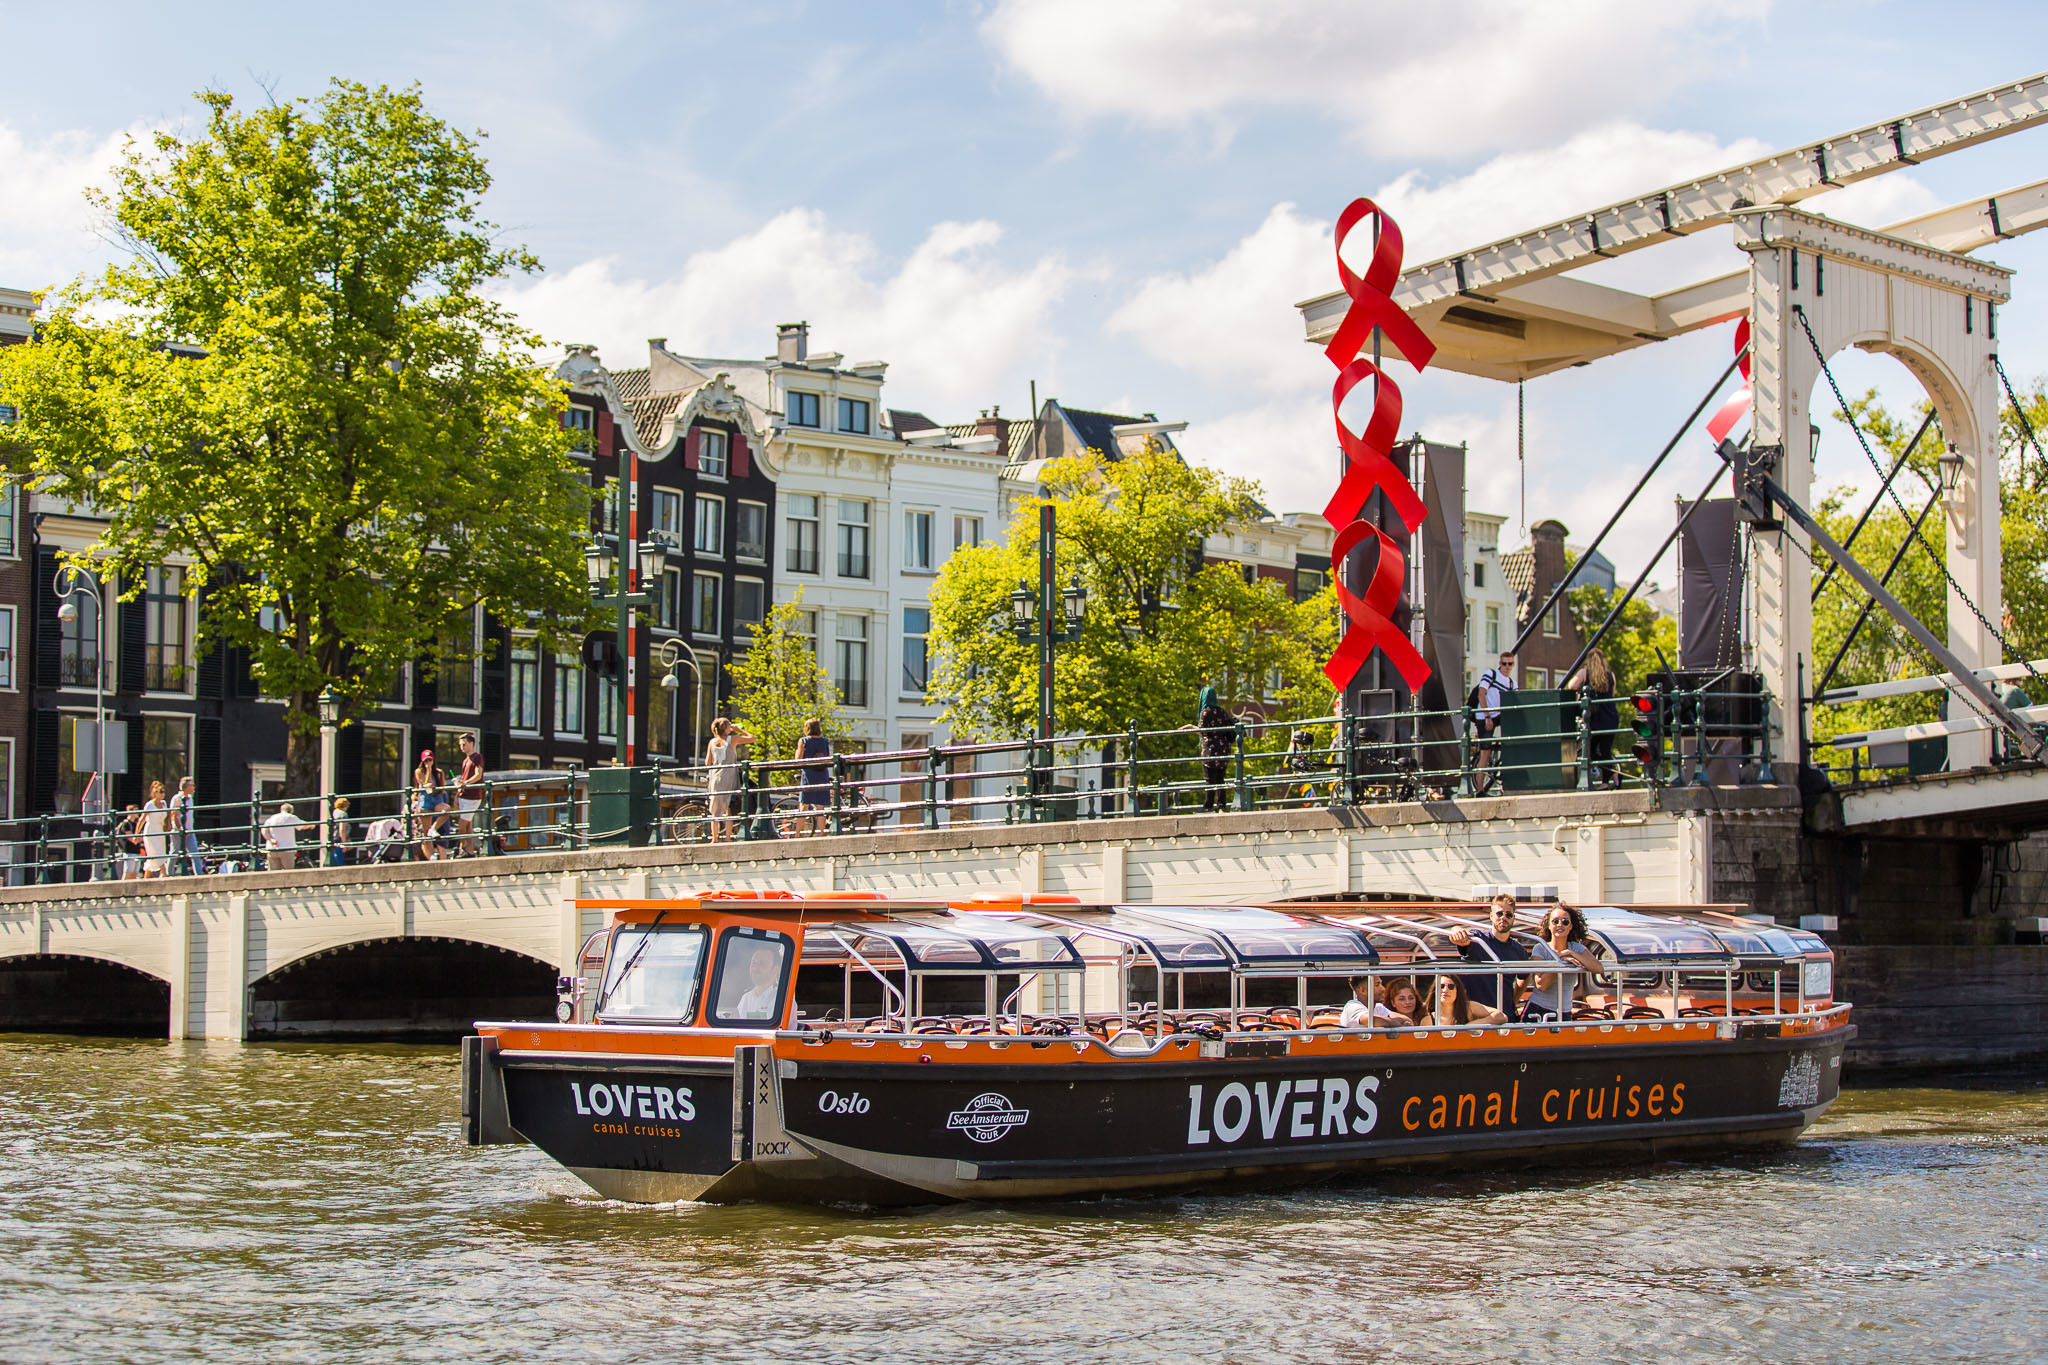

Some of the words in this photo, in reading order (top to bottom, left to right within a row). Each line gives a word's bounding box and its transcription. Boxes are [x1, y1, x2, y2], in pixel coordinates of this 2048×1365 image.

[570, 1082, 696, 1121] LOVERS
[818, 1090, 870, 1114] Oslo
[973, 1095, 1005, 1109] Official
[1187, 1075, 1380, 1145] LOVERS
[1402, 1079, 1520, 1131] canal
[1541, 1074, 1686, 1123] cruises
[593, 1121, 629, 1135] canal
[633, 1124, 681, 1138] cruises
[975, 1130, 999, 1140] TOUR
[756, 1141, 791, 1156] DOCK
